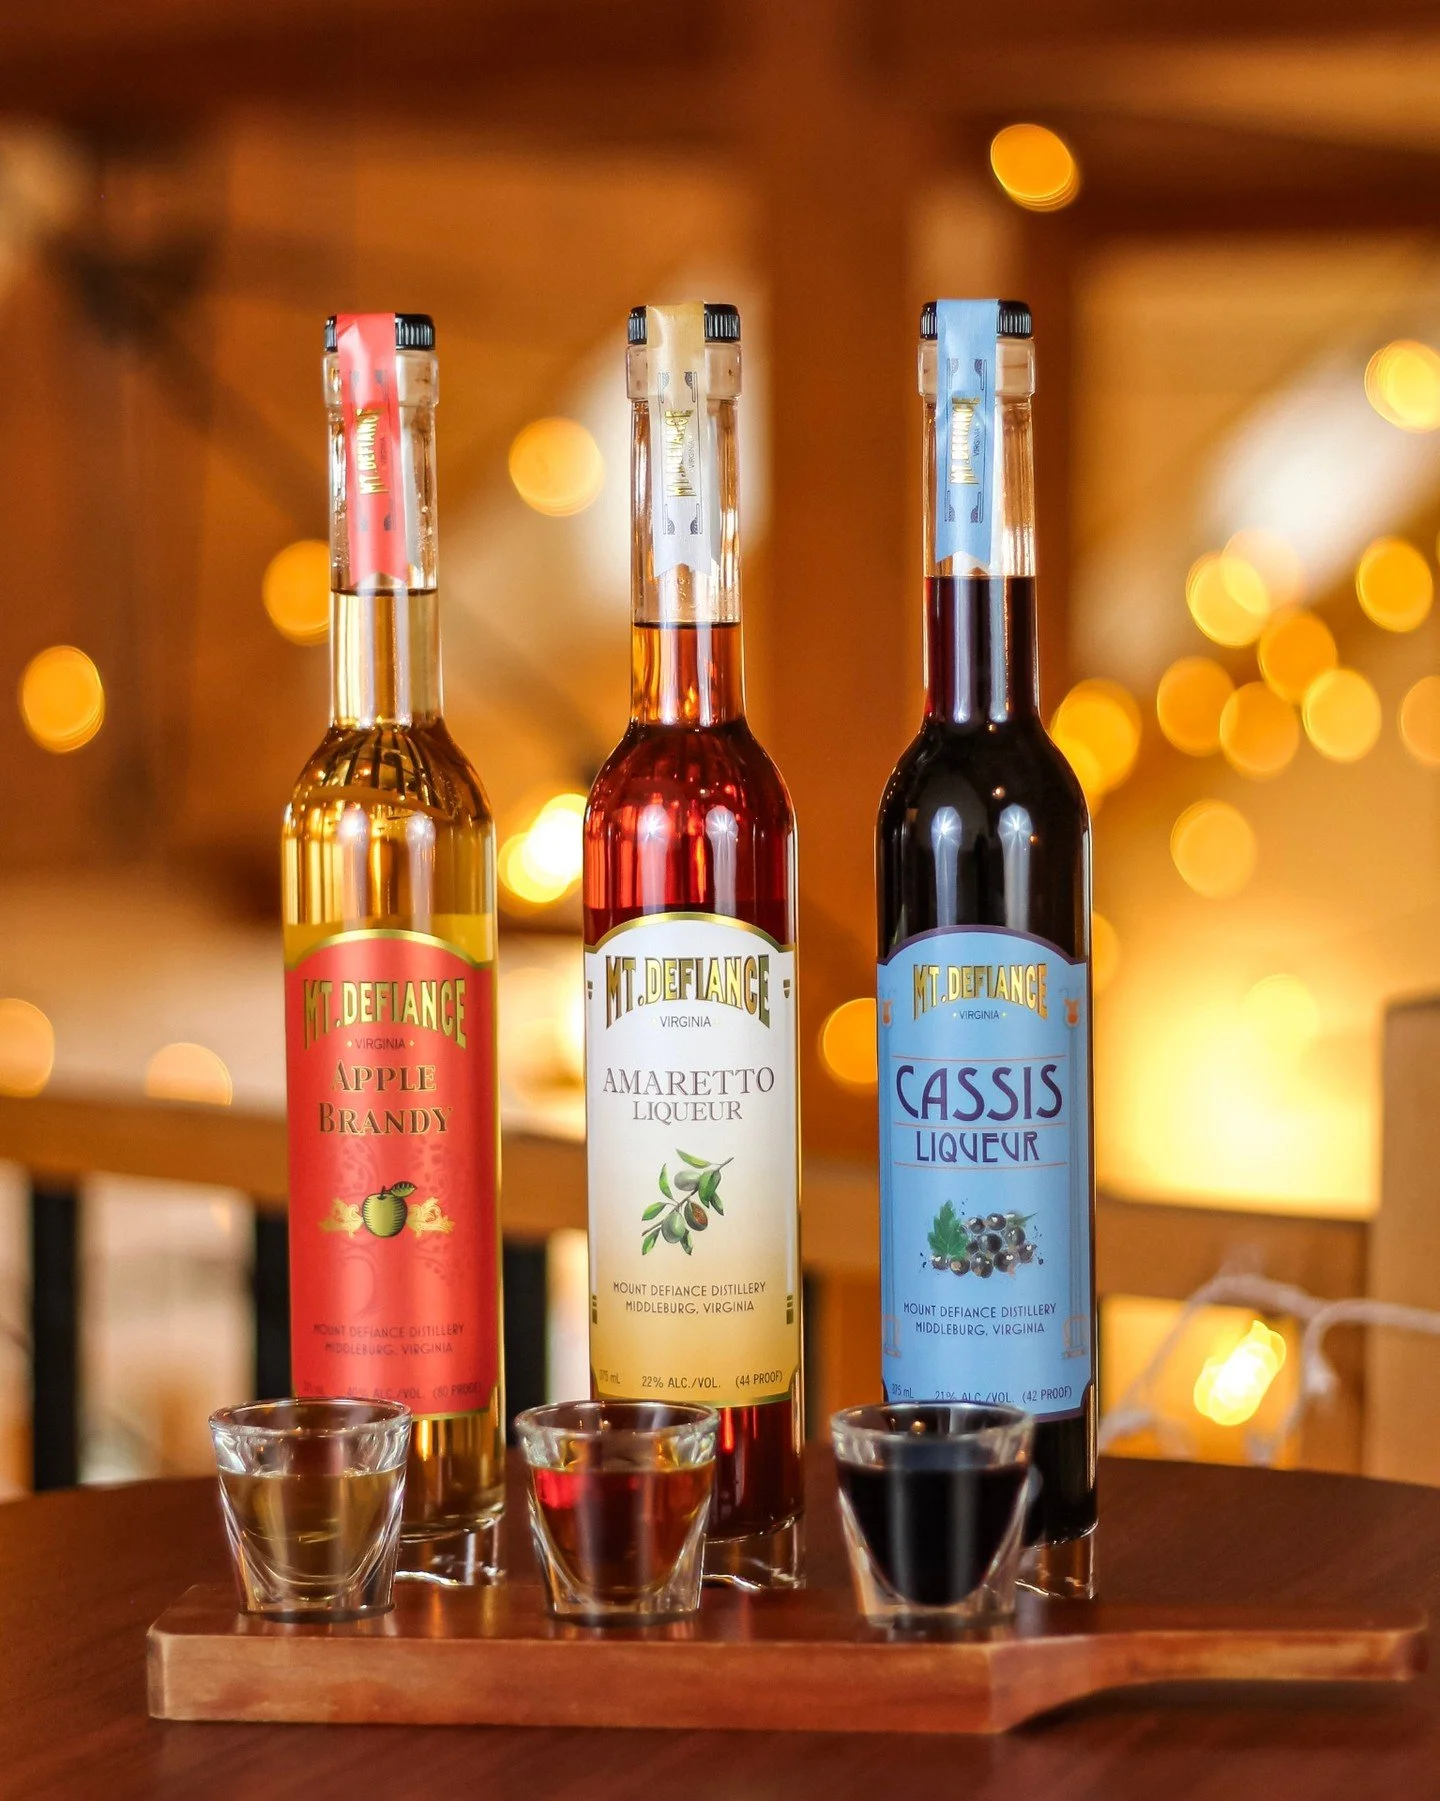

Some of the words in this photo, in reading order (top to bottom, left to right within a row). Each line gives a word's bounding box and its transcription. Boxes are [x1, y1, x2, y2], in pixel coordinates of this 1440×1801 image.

[660, 1015, 712, 1029] VIRGINIA
[959, 1010, 1000, 1021] VIRGINIA
[356, 1038, 406, 1050] VIRGINIA
[332, 1058, 437, 1092] APPLE
[602, 1066, 776, 1097] AMARETTO
[896, 1063, 1064, 1123] CASSIS
[319, 1102, 451, 1136] BRANDY
[632, 1100, 744, 1125] LIQUEUR
[915, 1130, 1041, 1165] LIQUEUR
[614, 1282, 646, 1296] MOUNT
[650, 1284, 707, 1297] DEFIANCE
[711, 1282, 766, 1296] DISTILLERY
[626, 1301, 699, 1315] MIDDLEBURG,
[703, 1301, 754, 1314] VIRGINIA
[904, 1302, 936, 1316] MOUNT
[940, 1306, 996, 1319] DEFIANCE
[1001, 1302, 1057, 1318] DISTILLERY
[314, 1323, 346, 1336] MOUNT
[350, 1326, 404, 1338] DEFIANCE
[410, 1323, 464, 1338] DISTILLERY
[916, 1322, 988, 1336] MIDDLEBURG,
[992, 1322, 1045, 1336] VIRGINIA
[402, 1342, 453, 1355] VIRGINIA
[642, 1375, 664, 1388] 22%
[736, 1375, 750, 1389] (44
[754, 1370, 782, 1385] PROOF)
[1022, 1390, 1038, 1404] (42
[1040, 1385, 1072, 1400] PROOF)
